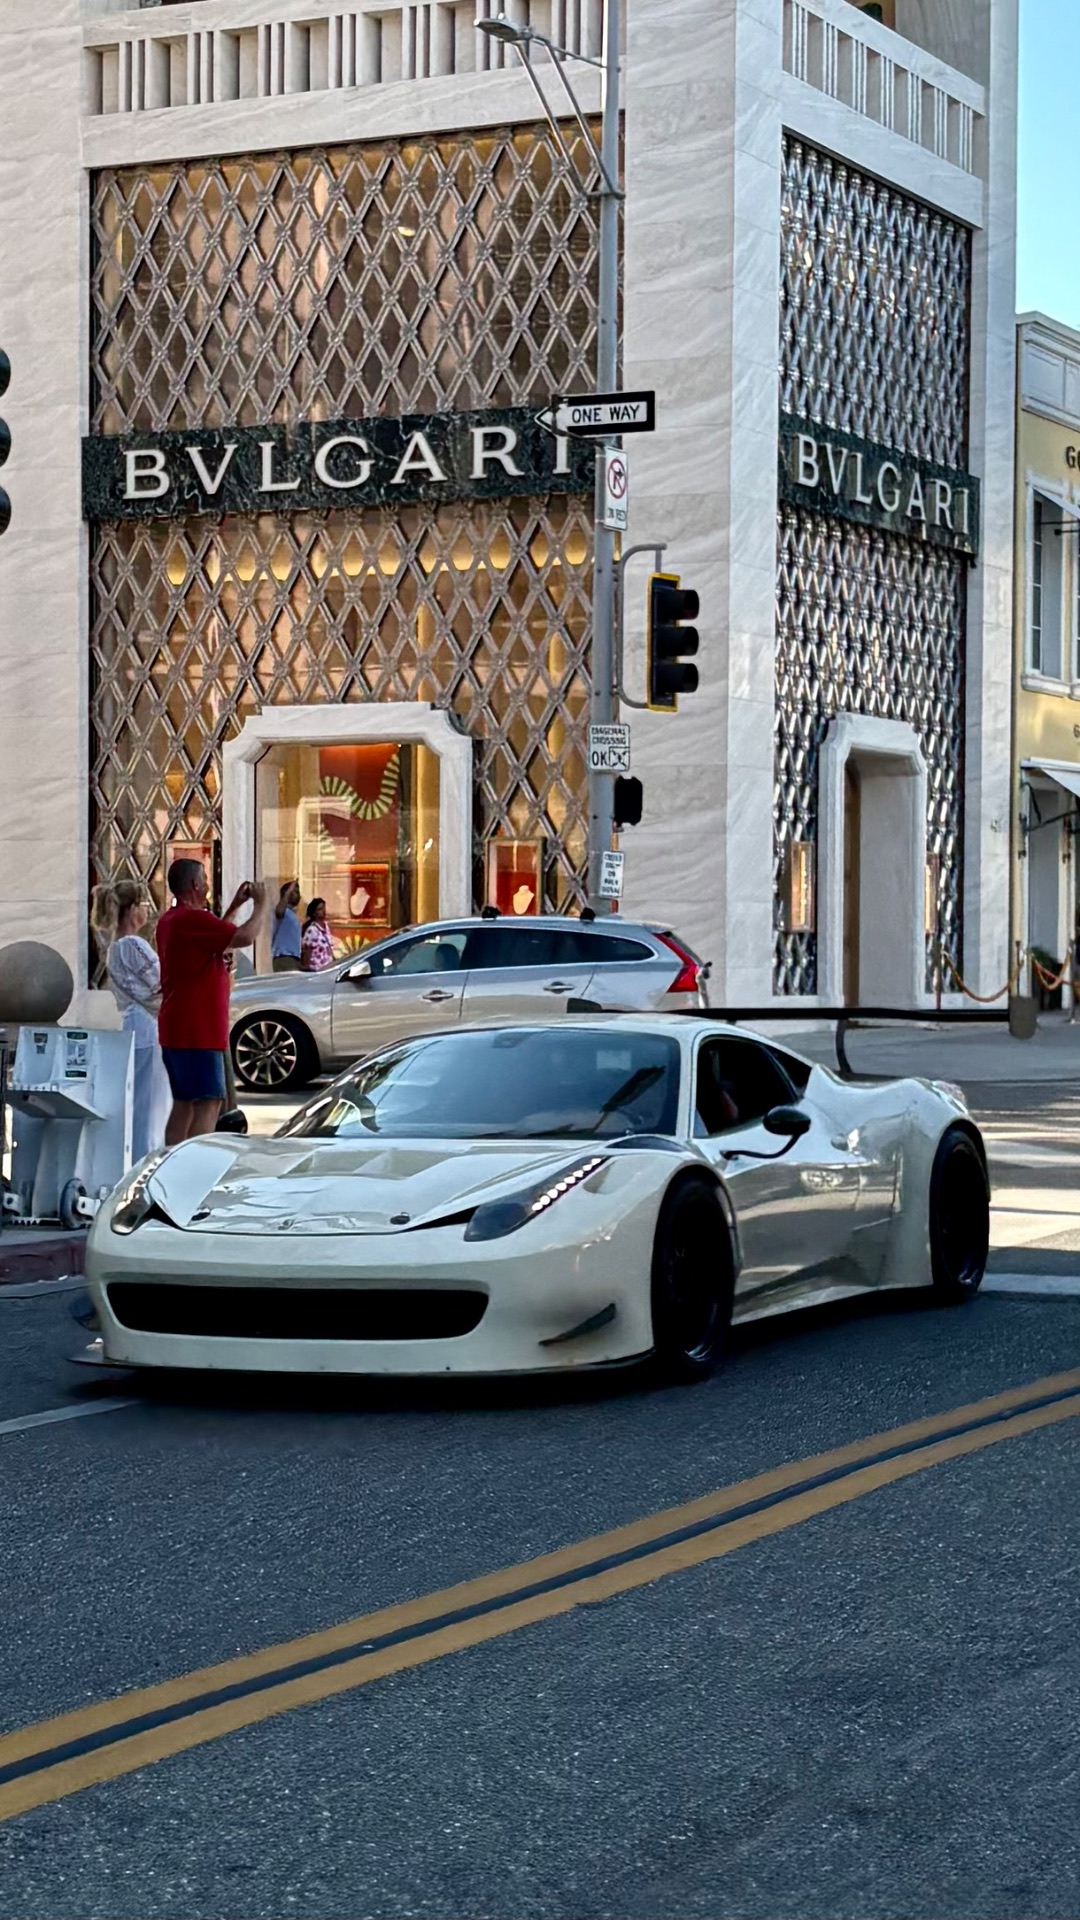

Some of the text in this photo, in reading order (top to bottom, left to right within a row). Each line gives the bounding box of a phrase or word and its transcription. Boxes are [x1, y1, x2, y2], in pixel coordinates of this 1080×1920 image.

[571, 404, 640, 424] ONE WAY
[122, 425, 572, 500] BVLGARI
[796, 433, 970, 535] BVLGARI
[592, 751, 608, 766] OK
